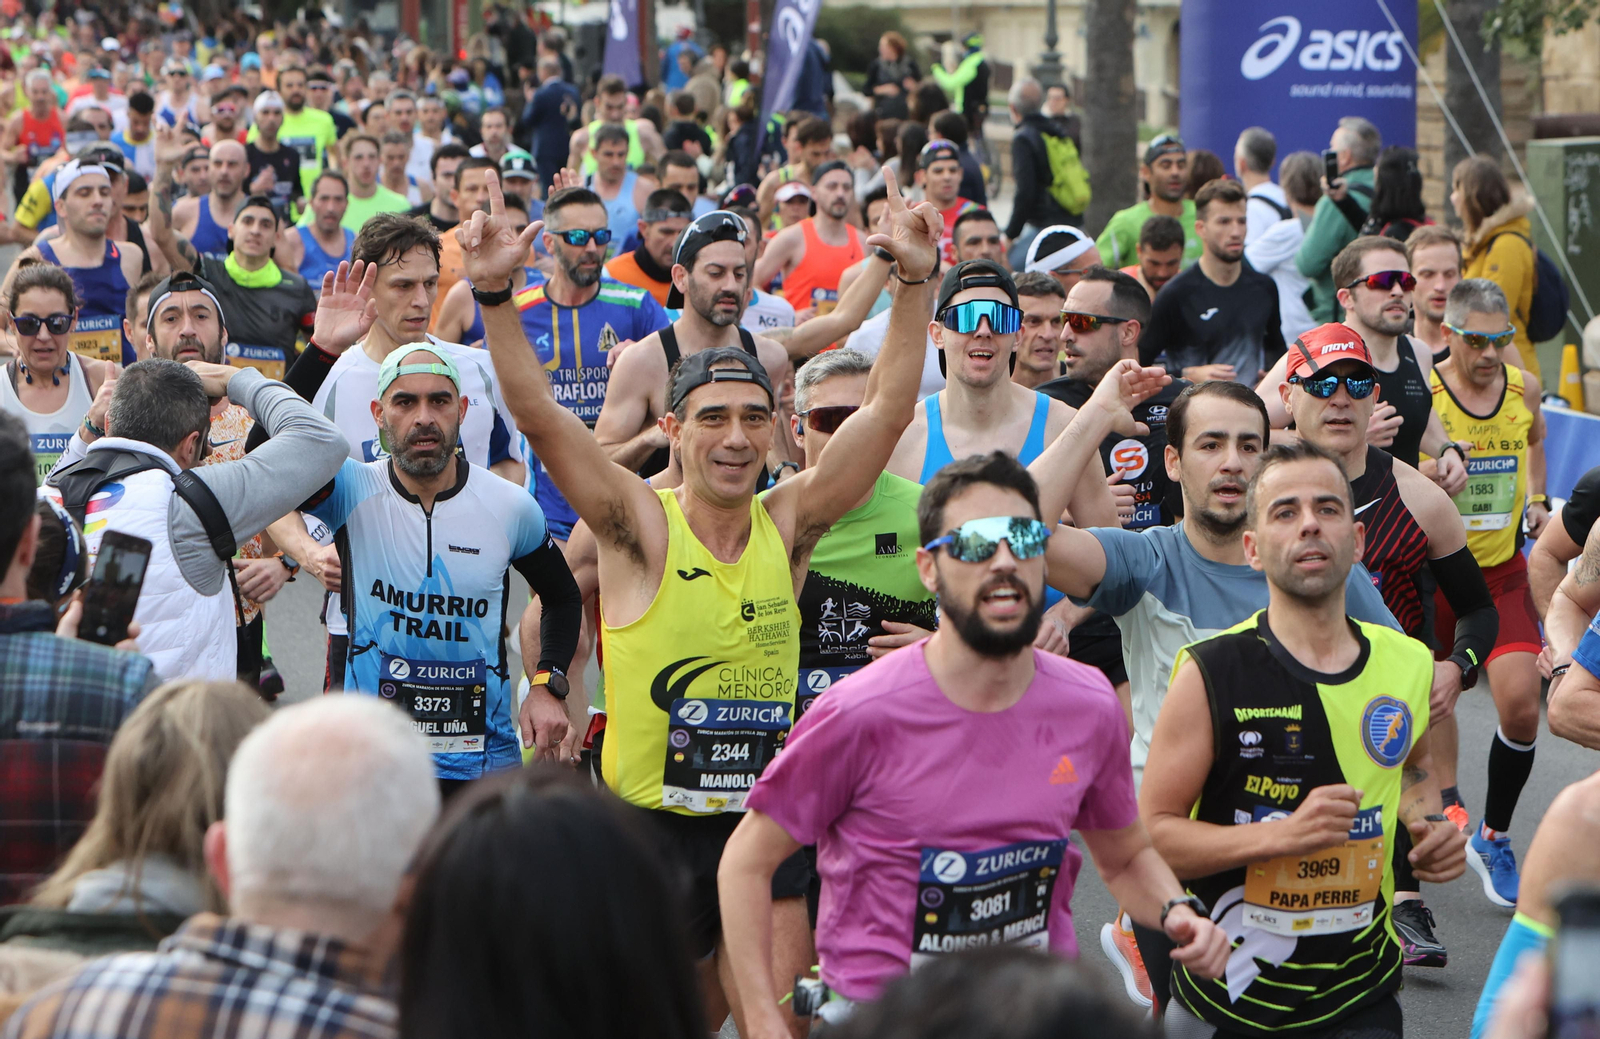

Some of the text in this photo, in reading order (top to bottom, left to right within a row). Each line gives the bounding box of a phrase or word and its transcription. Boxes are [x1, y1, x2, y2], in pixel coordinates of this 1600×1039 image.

[1299, 30, 1402, 71] asics
[1290, 81, 1333, 98] sound
[243, 347, 279, 359] ZURICH
[559, 367, 576, 382] TRI
[580, 366, 612, 380] SPOR
[551, 381, 609, 401] RAFLOR
[1469, 459, 1510, 471] ZURICH
[1469, 484, 1494, 495] 1583
[1472, 503, 1492, 513] GABI
[878, 544, 903, 554] AMS
[370, 579, 488, 618] AMURRIO
[389, 611, 469, 642] TRAIL
[747, 620, 790, 635] BERKSHIRE
[749, 629, 790, 642] HATHAWAY
[763, 649, 779, 657] Spain
[416, 666, 476, 679] ZURICH
[719, 665, 784, 682] CLÍNICA
[414, 696, 451, 712] 3373
[716, 706, 781, 723] ZURICH
[1233, 704, 1302, 723] DEPORTEMANIA
[443, 719, 468, 733] UÑA
[710, 742, 750, 761] 2344
[700, 773, 756, 788] MANOLO
[975, 846, 1050, 877] ZURICH
[1297, 857, 1341, 879] 3969
[970, 890, 1012, 921] 3081
[1269, 889, 1360, 908] PAPA PERRE
[919, 932, 988, 952] ALONSO
[1003, 908, 1047, 942] MENCÍ
